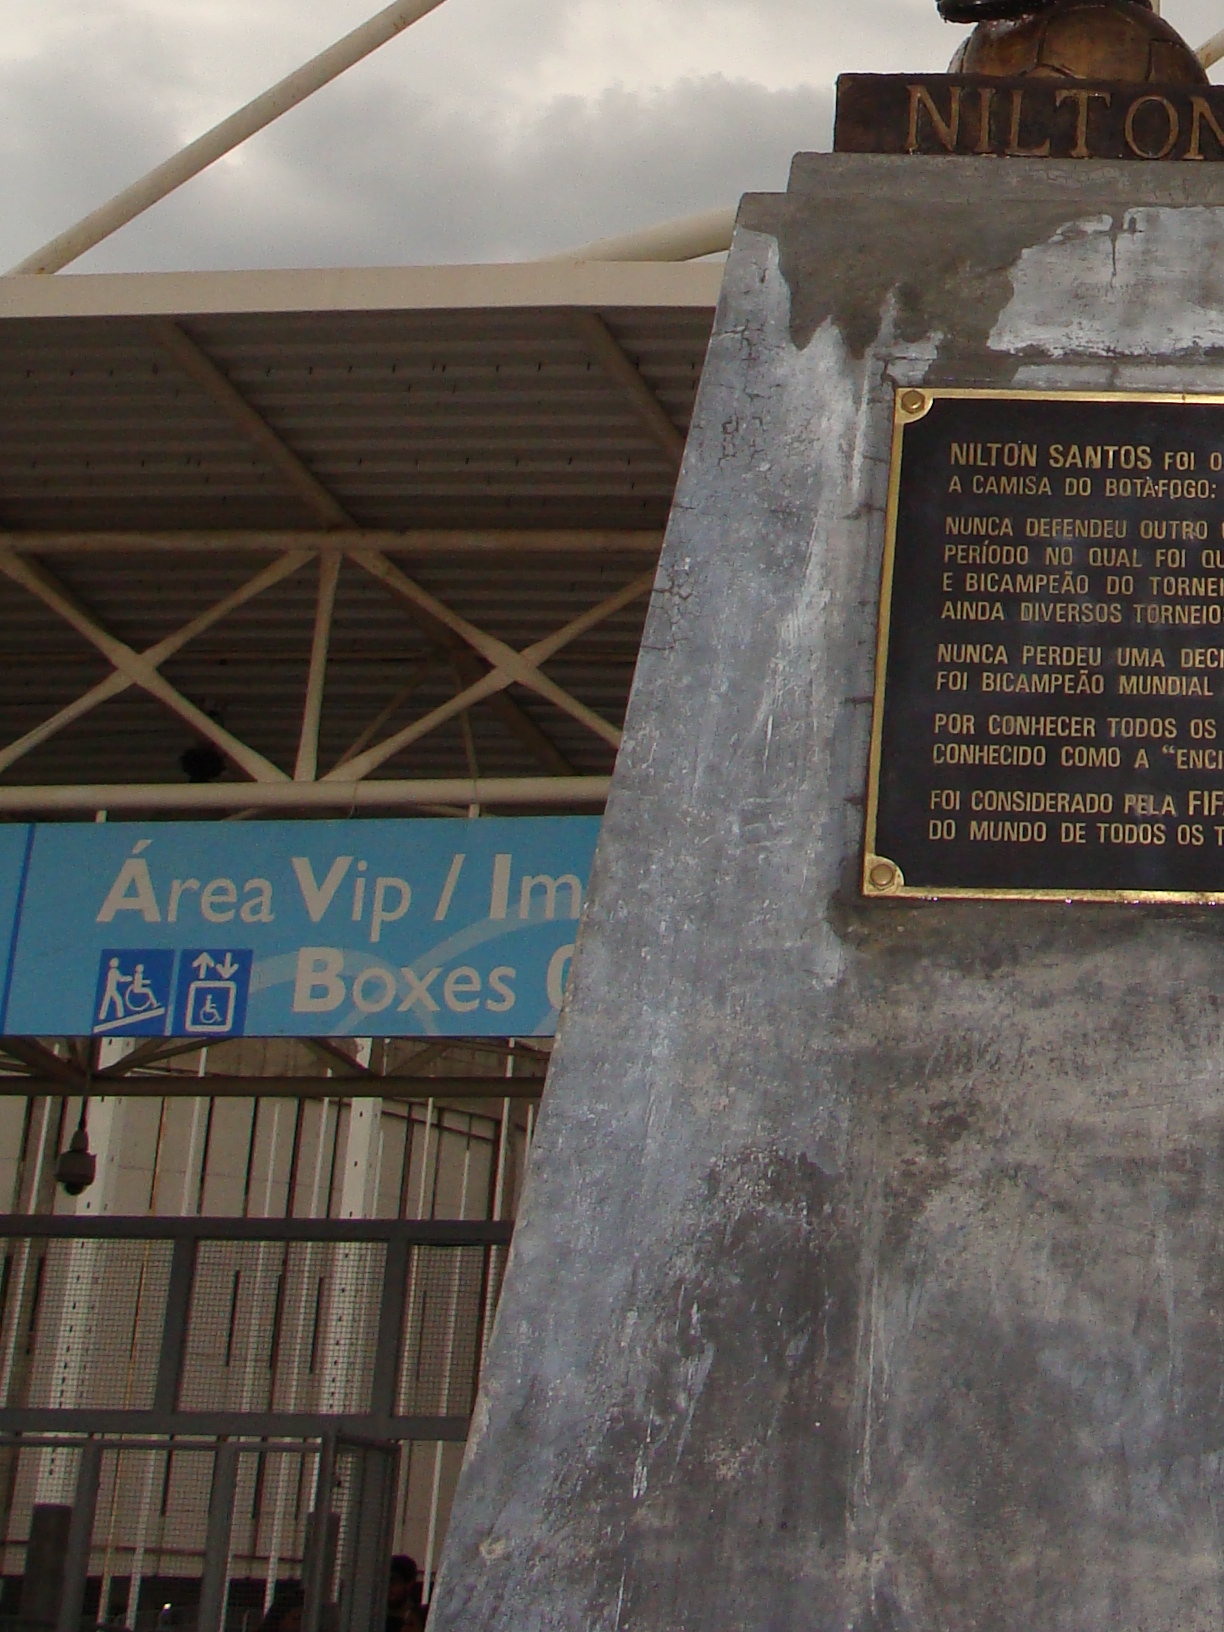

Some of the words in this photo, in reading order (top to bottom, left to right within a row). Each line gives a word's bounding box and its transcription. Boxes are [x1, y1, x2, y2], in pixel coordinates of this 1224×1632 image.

[950, 440, 1038, 468] NILTON
[1048, 443, 1153, 470] SANTOS
[1163, 451, 1195, 471] FOI
[1209, 451, 1223, 472] O
[948, 475, 962, 494] A
[972, 474, 1053, 496] CAMISA
[1064, 476, 1092, 497] DO
[1104, 477, 1217, 500] BOTAFOGO:
[945, 516, 1014, 537] NUNCA
[1025, 517, 1128, 539] DEFENDEU
[1139, 519, 1208, 542] OUTRO
[943, 539, 1029, 566] PERÍODO
[1044, 546, 1074, 566] NO
[1088, 547, 1143, 568] QUAL
[1155, 548, 1186, 569] FOI
[942, 571, 954, 592] E
[965, 570, 1089, 595] BICAMPEÃO
[1106, 575, 1134, 595] DO
[940, 600, 1005, 621] AINDA
[1020, 601, 1123, 624] DIVERSOS
[937, 643, 1009, 665] NUNCA
[1021, 644, 1102, 667] PERDEU
[1115, 646, 1166, 668] UMA
[936, 670, 968, 691] FOI
[981, 669, 1105, 695] BICAMPEÃO
[1117, 674, 1214, 697] MUNDIAL
[933, 713, 975, 735] POR
[988, 714, 1096, 738] CONHECER
[1106, 717, 1178, 739] TODOS
[1189, 718, 1217, 740] OS
[932, 743, 1047, 767] CONHECIDO
[1060, 745, 1121, 768] COMO
[1133, 748, 1150, 770] A
[930, 789, 961, 811] FOI
[970, 789, 1113, 814] CONSIDERADO
[1123, 793, 1178, 818] PELA
[928, 818, 956, 841] DO
[969, 820, 1047, 843] MUNDO
[1060, 821, 1087, 844] DE
[1095, 822, 1167, 846] TODOS
[1177, 823, 1205, 846] OS
[96, 839, 275, 923] Área
[291, 855, 412, 943] Vip
[291, 946, 517, 1013] Boxes
